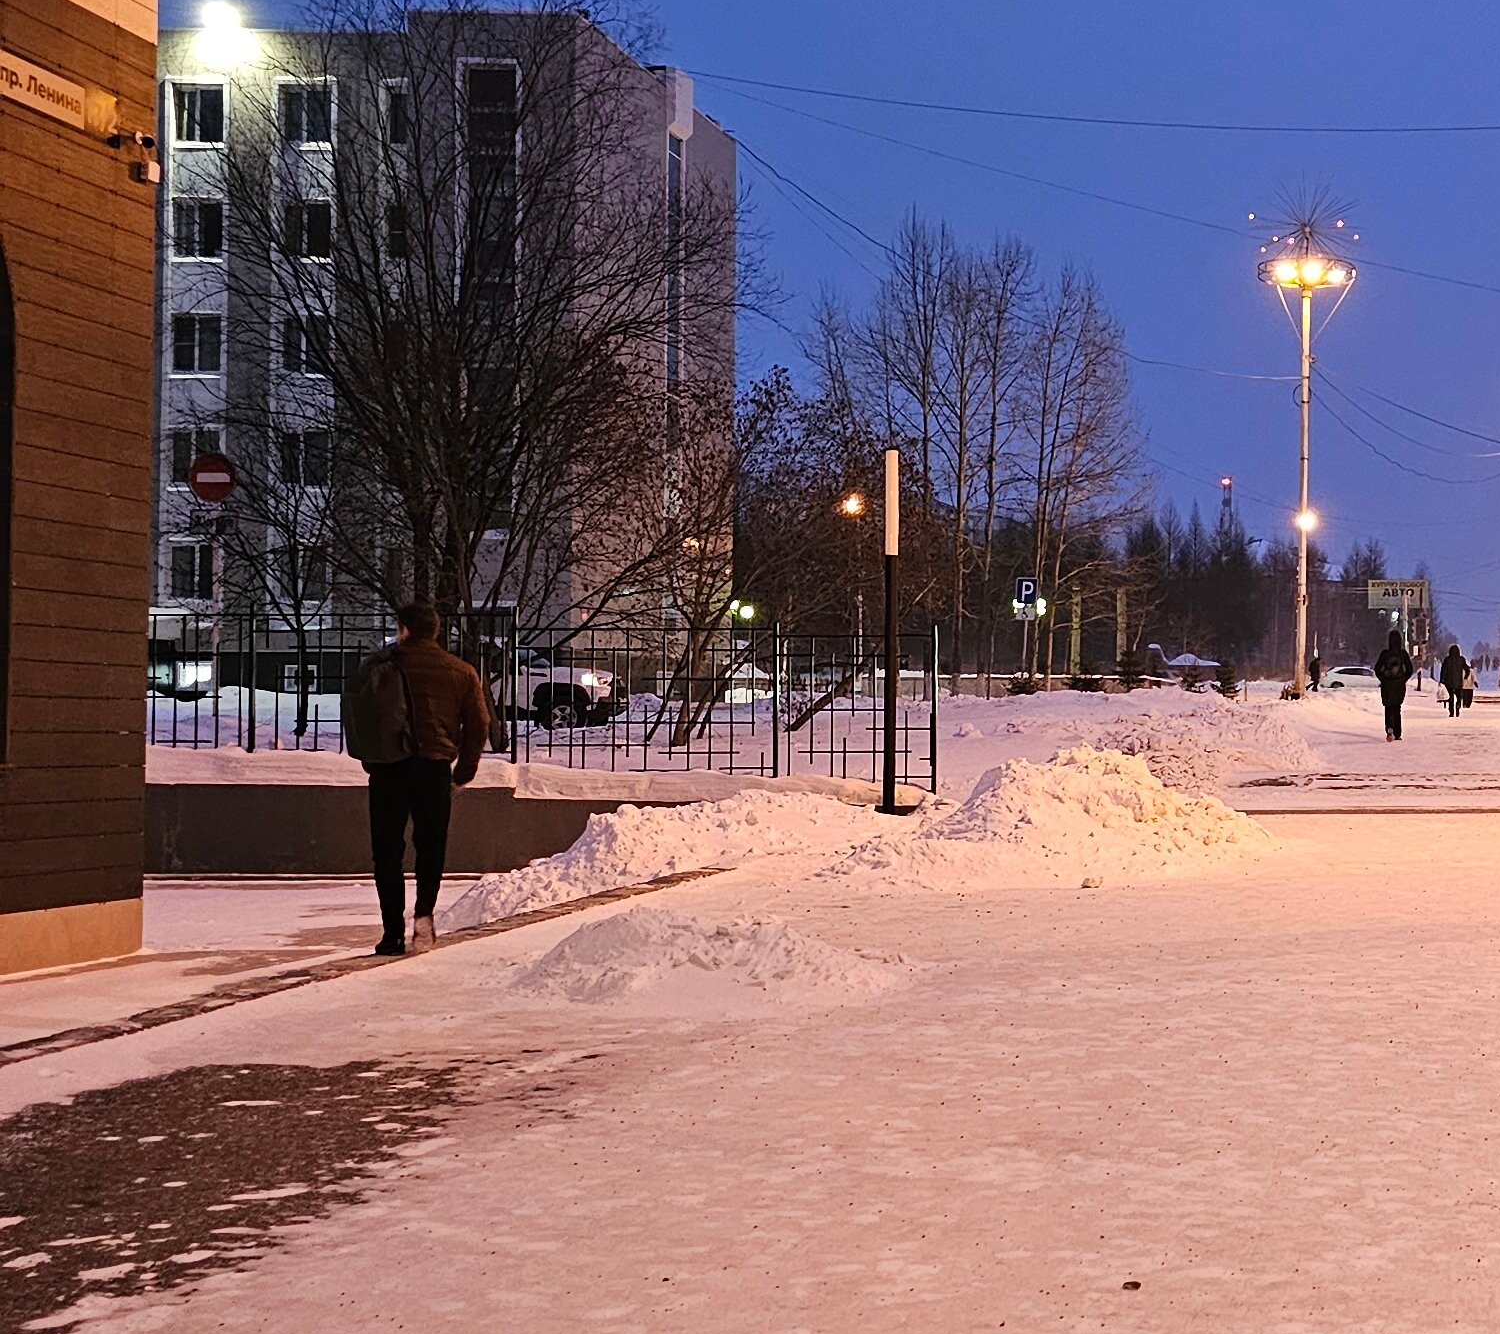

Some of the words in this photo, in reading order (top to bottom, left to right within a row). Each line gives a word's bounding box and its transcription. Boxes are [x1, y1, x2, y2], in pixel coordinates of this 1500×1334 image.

[0, 66, 22, 89] пр.
[26, 75, 81, 115] Ленина
[1021, 581, 1034, 601] P
[1382, 588, 1415, 597] АВТО
